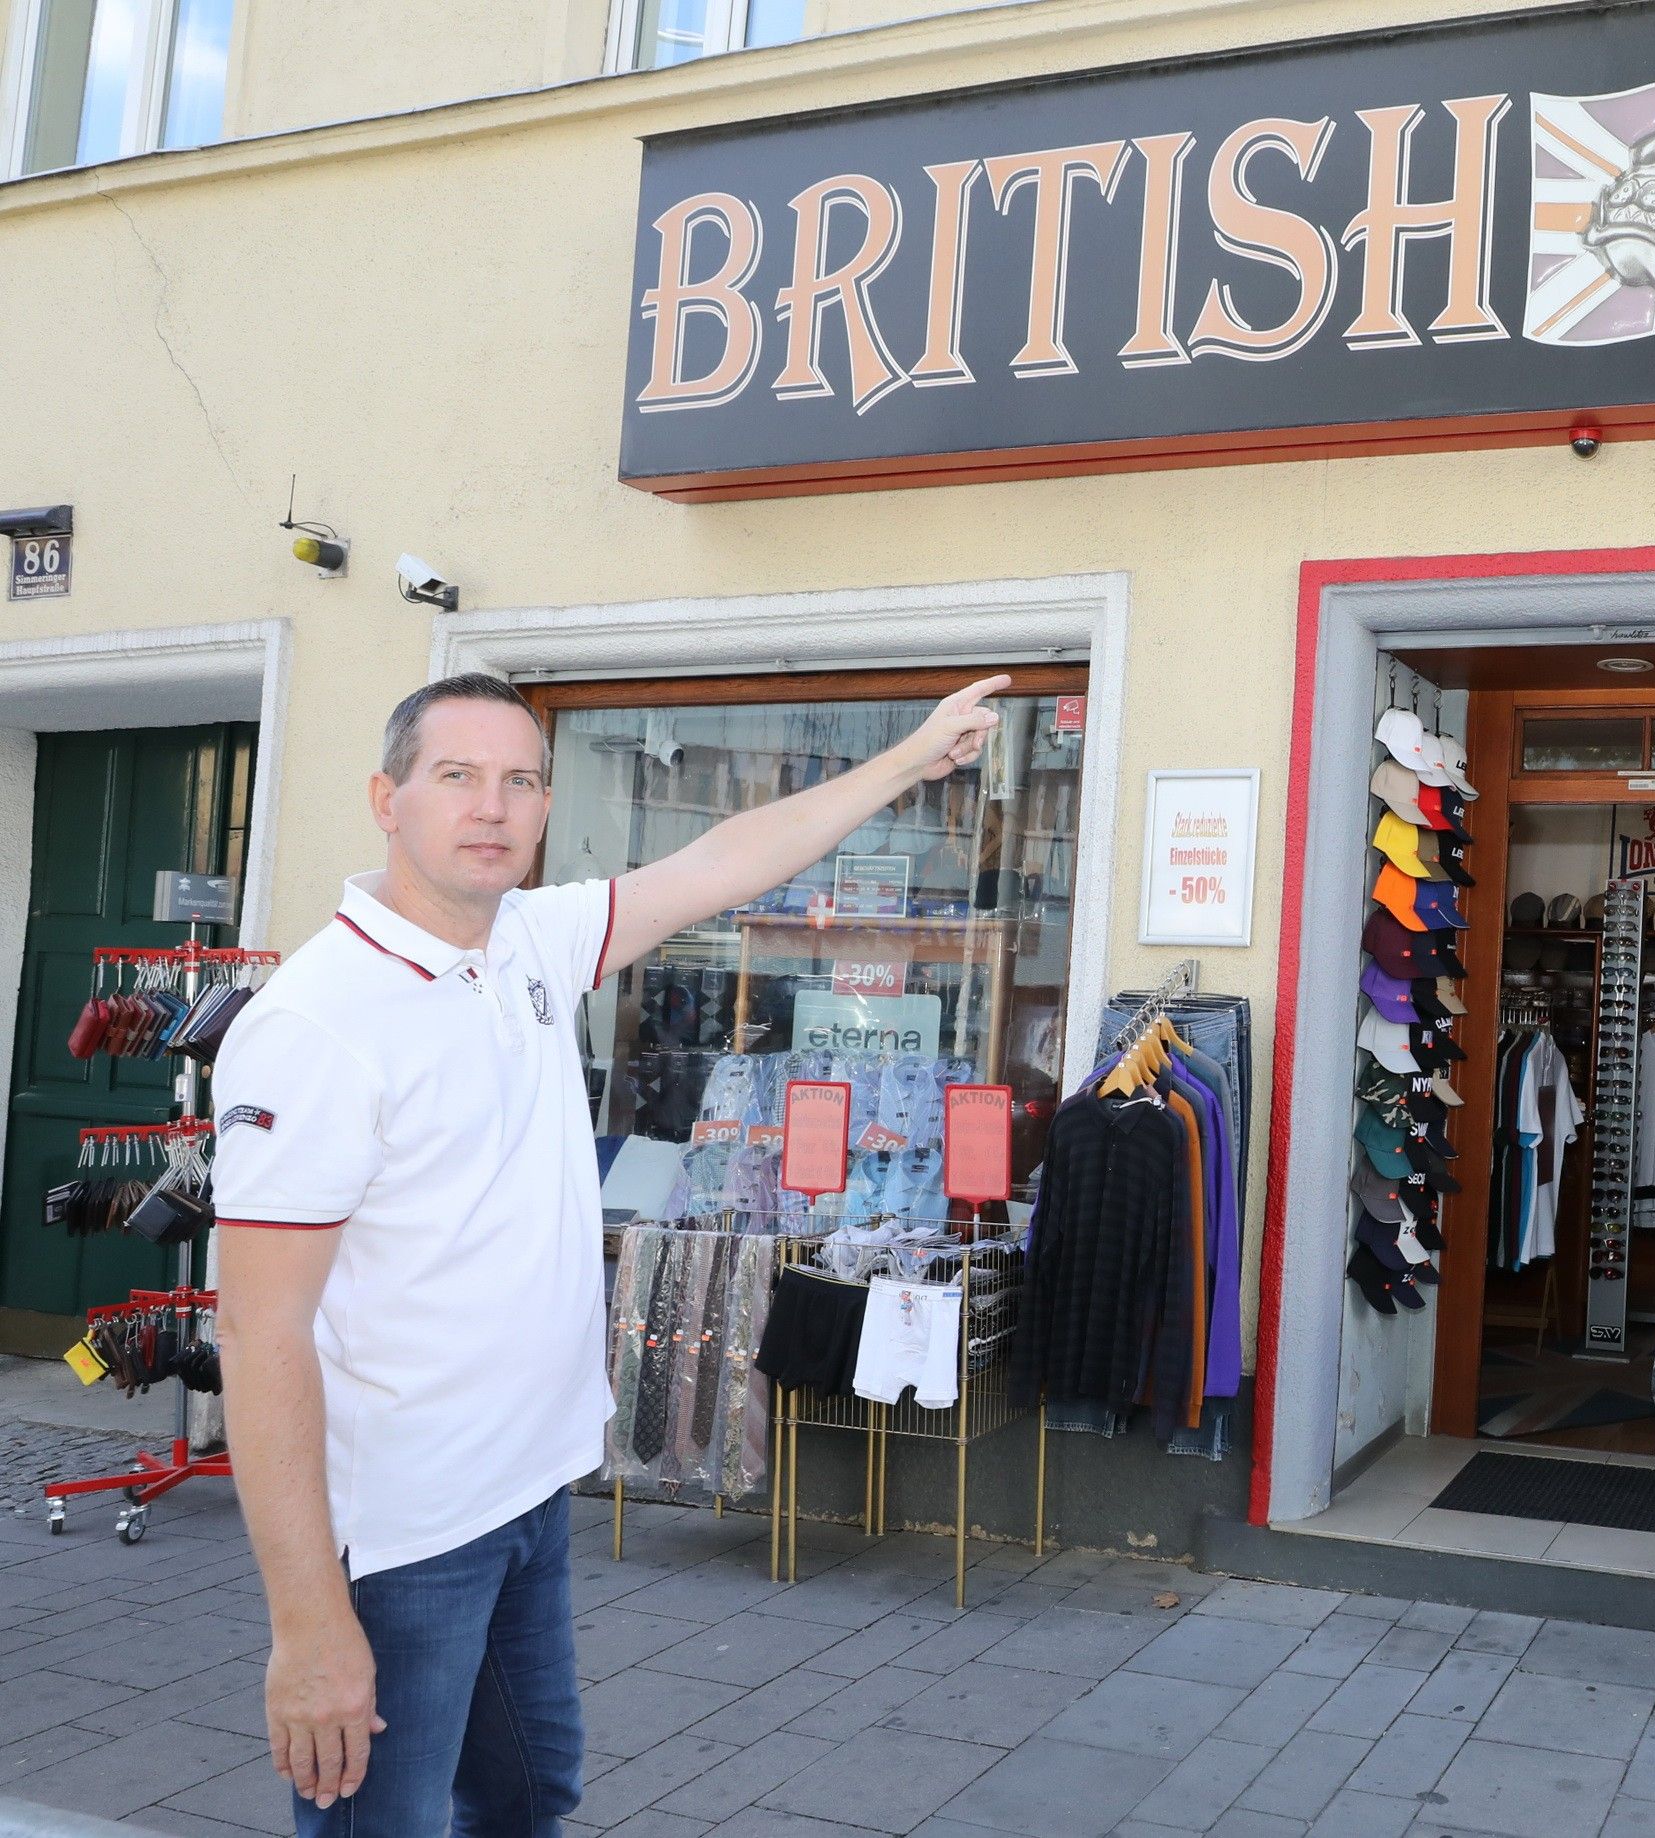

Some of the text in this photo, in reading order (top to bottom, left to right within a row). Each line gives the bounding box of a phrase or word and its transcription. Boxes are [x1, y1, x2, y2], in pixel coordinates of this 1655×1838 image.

[637, 93, 1513, 416] BRITISH
[24, 539, 60, 574] 86
[15, 572, 67, 584] Simmeringer
[16, 583, 65, 595] Hauptstraße
[1171, 811, 1193, 838] Stark
[1169, 847, 1228, 866] Einzelstücke
[1181, 876, 1226, 904] 50%
[842, 963, 895, 988] -30%
[808, 1022, 922, 1051] eterna
[791, 1088, 844, 1107] AKTION
[950, 1091, 1006, 1111] AKTION
